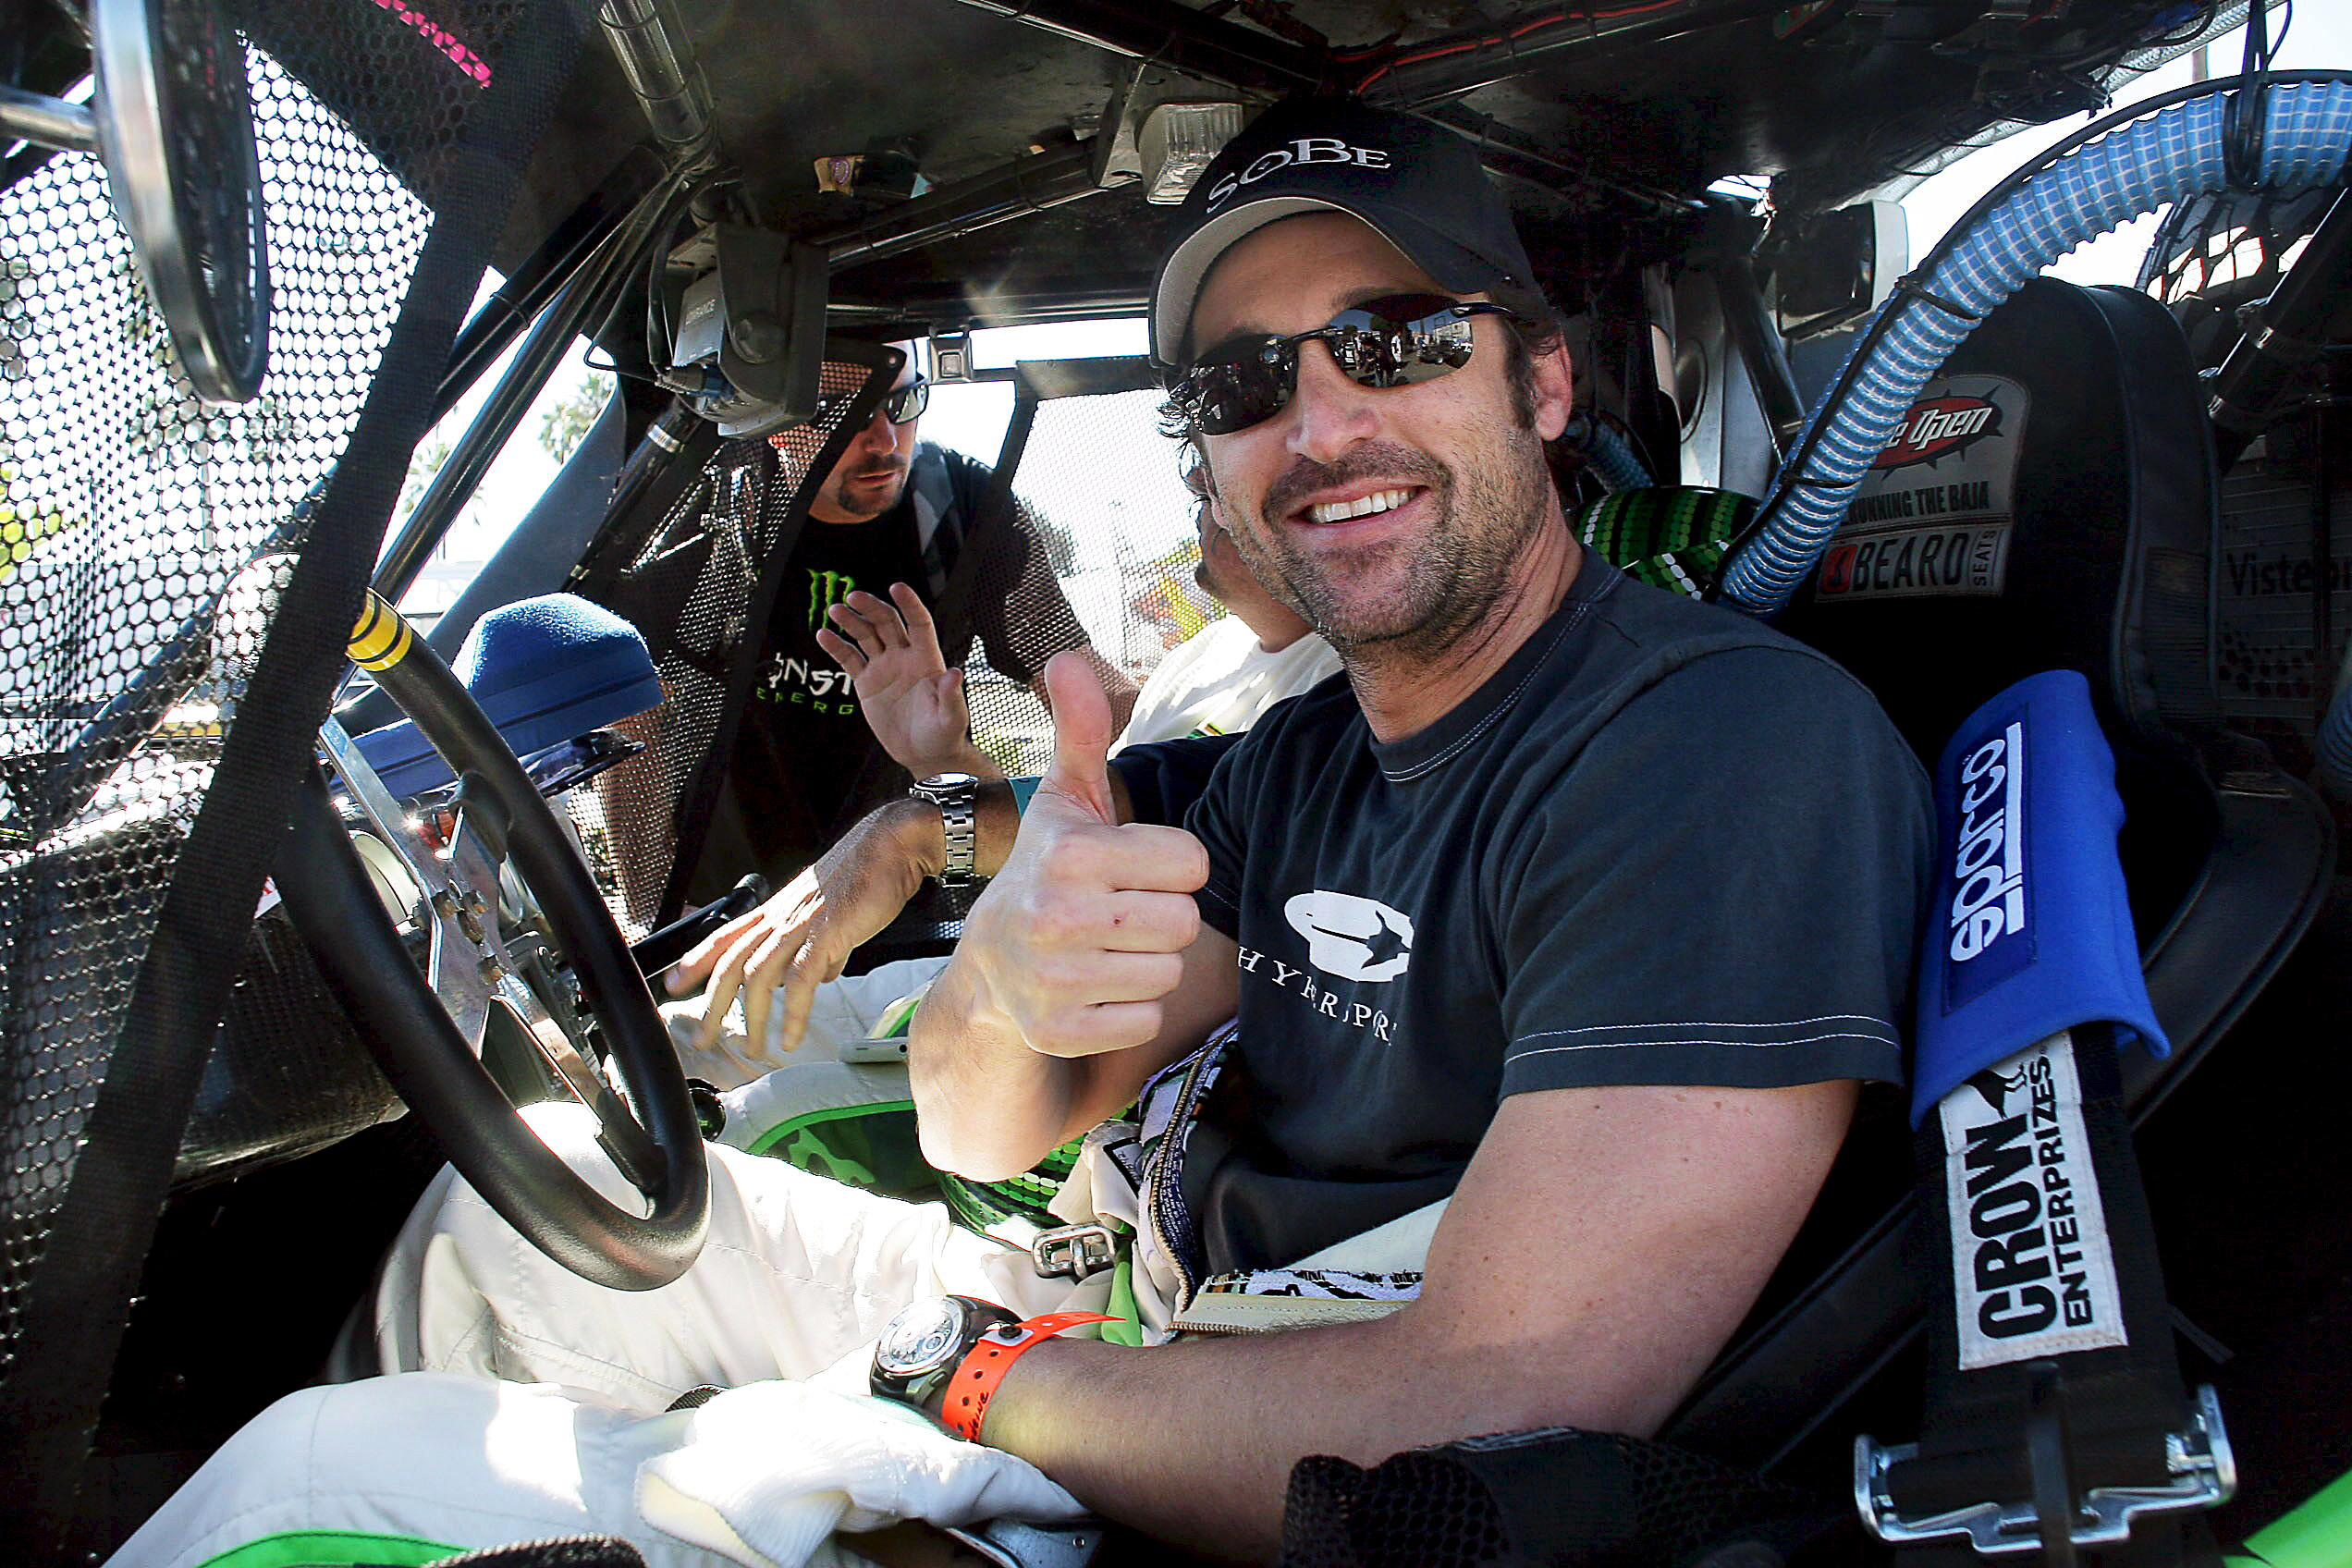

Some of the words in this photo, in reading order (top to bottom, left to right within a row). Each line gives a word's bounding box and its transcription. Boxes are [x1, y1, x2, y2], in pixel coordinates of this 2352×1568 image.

[1907, 407, 1993, 451] Open
[1916, 486, 1946, 516] THE
[1948, 480, 1990, 512] BAJA
[1950, 722, 2025, 962] sparco
[1964, 1112, 2058, 1340] CROW
[2029, 1055, 2094, 1328] ENTERPRIZES
